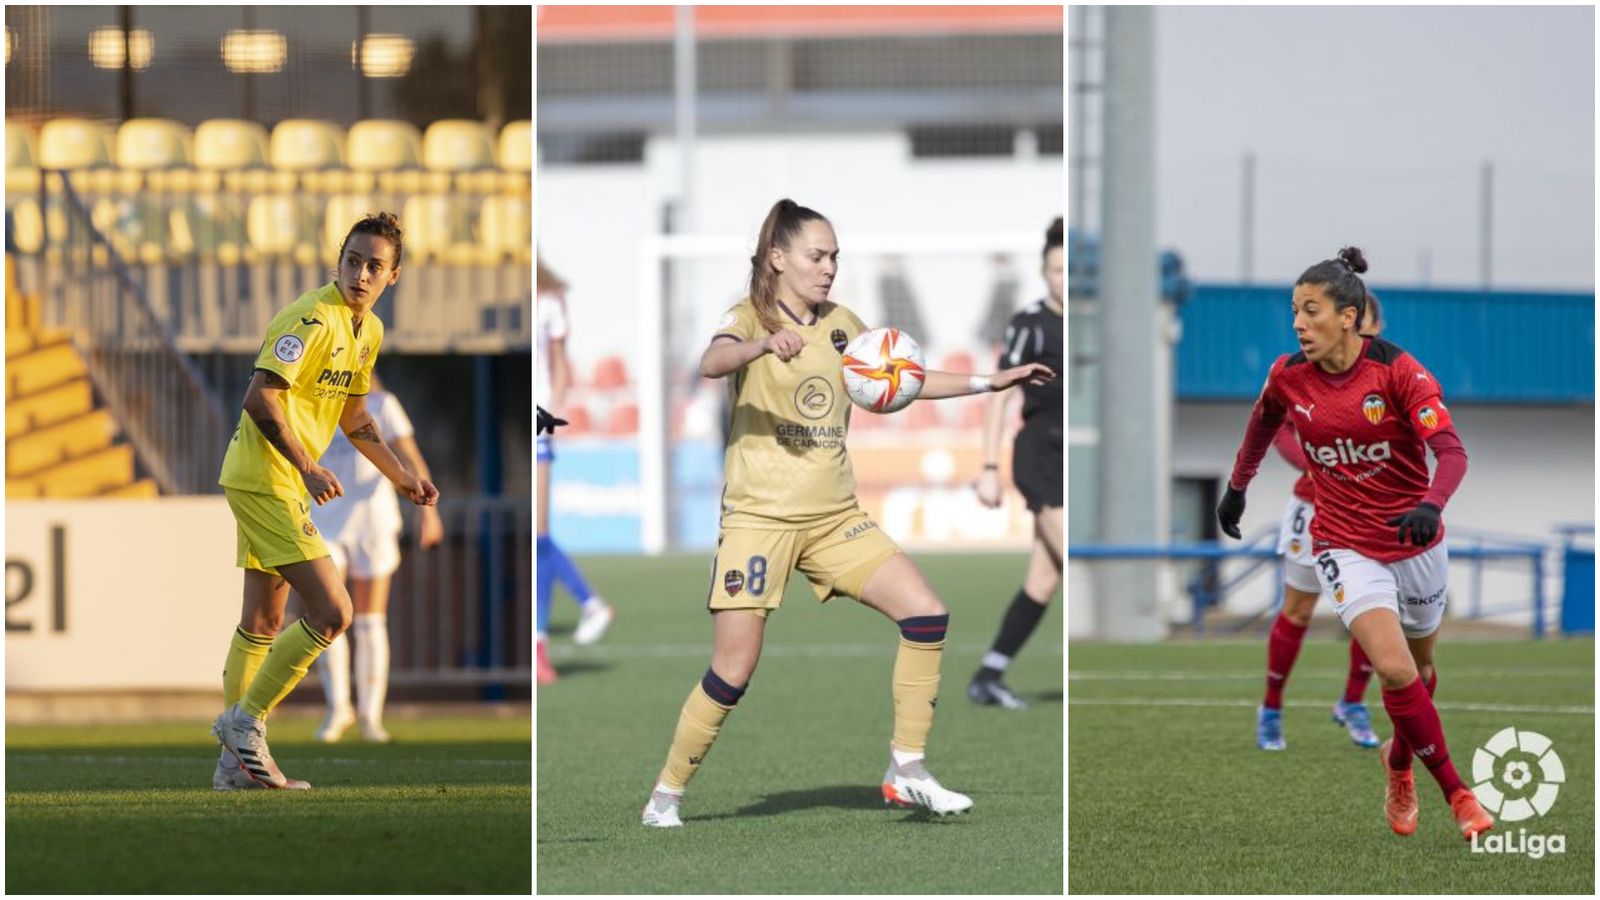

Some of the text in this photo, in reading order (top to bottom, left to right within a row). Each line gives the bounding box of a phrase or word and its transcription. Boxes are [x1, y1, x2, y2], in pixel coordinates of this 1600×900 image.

[317, 368, 358, 388] PAM
[776, 424, 843, 438] GERMAINE
[1303, 437, 1392, 467] teika
[1291, 505, 1306, 535] 6
[747, 554, 768, 597] 8
[1316, 551, 1340, 582] 5
